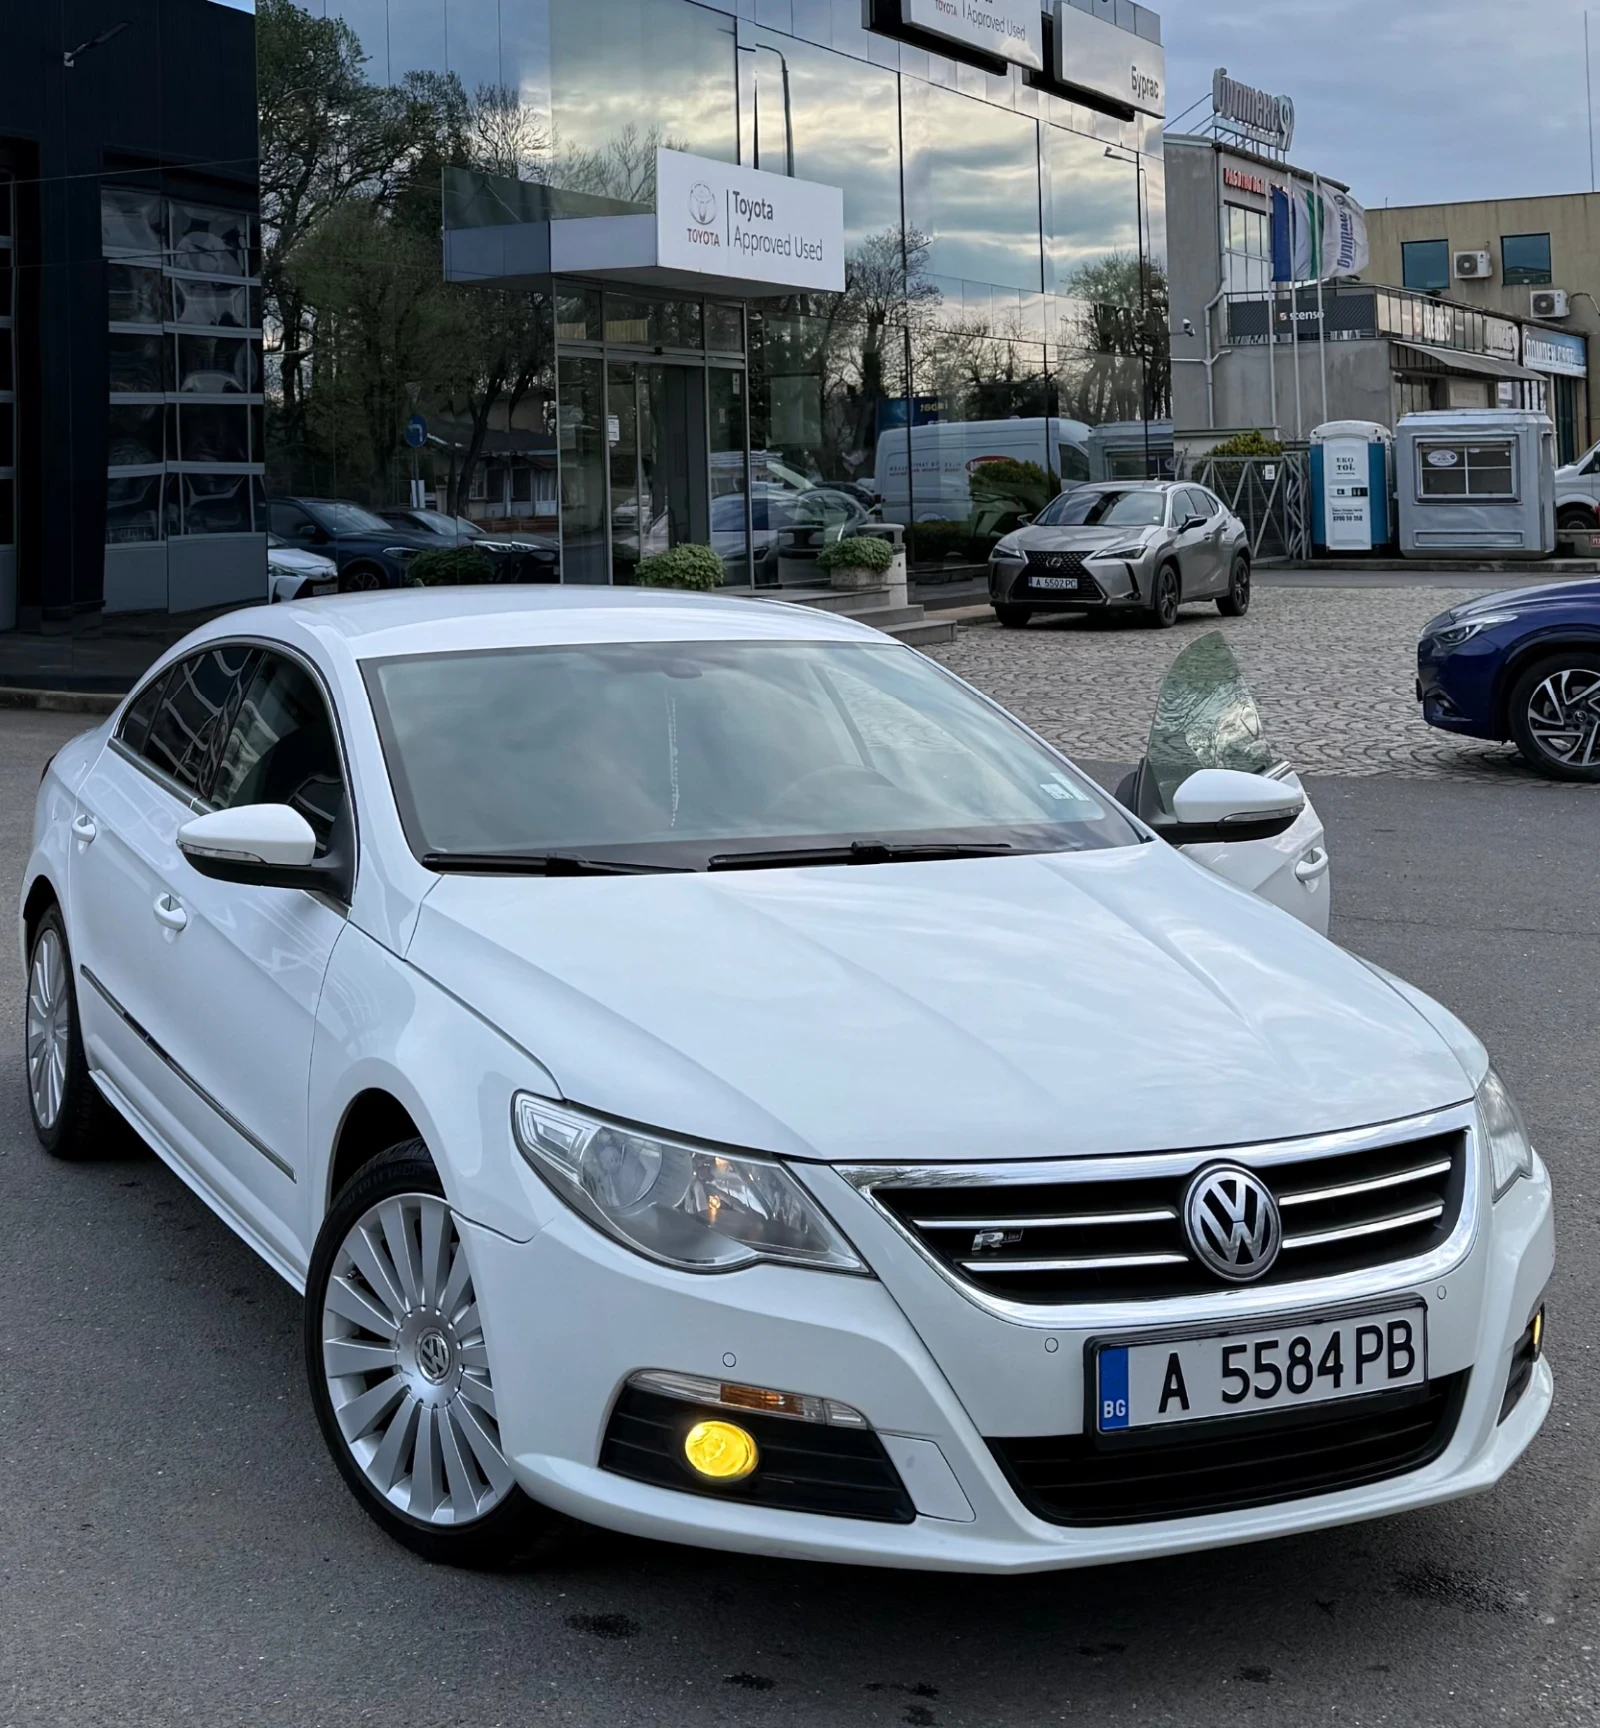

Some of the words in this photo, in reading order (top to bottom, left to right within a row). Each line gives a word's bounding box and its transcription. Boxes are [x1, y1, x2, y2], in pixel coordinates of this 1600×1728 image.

[935, 0, 958, 17] TOYOTA
[966, 3, 1006, 33] Approved
[1006, 19, 1026, 42] Used
[1131, 65, 1159, 100] Бургас
[732, 190, 774, 222] Toyota
[687, 227, 720, 247] TOYOTA
[733, 225, 792, 257] Approved
[794, 236, 823, 261] Used
[1103, 1399, 1126, 1419] BG
[1158, 1352, 1190, 1414] A
[1221, 1331, 1344, 1404] 5584
[1355, 1319, 1416, 1385] PB
